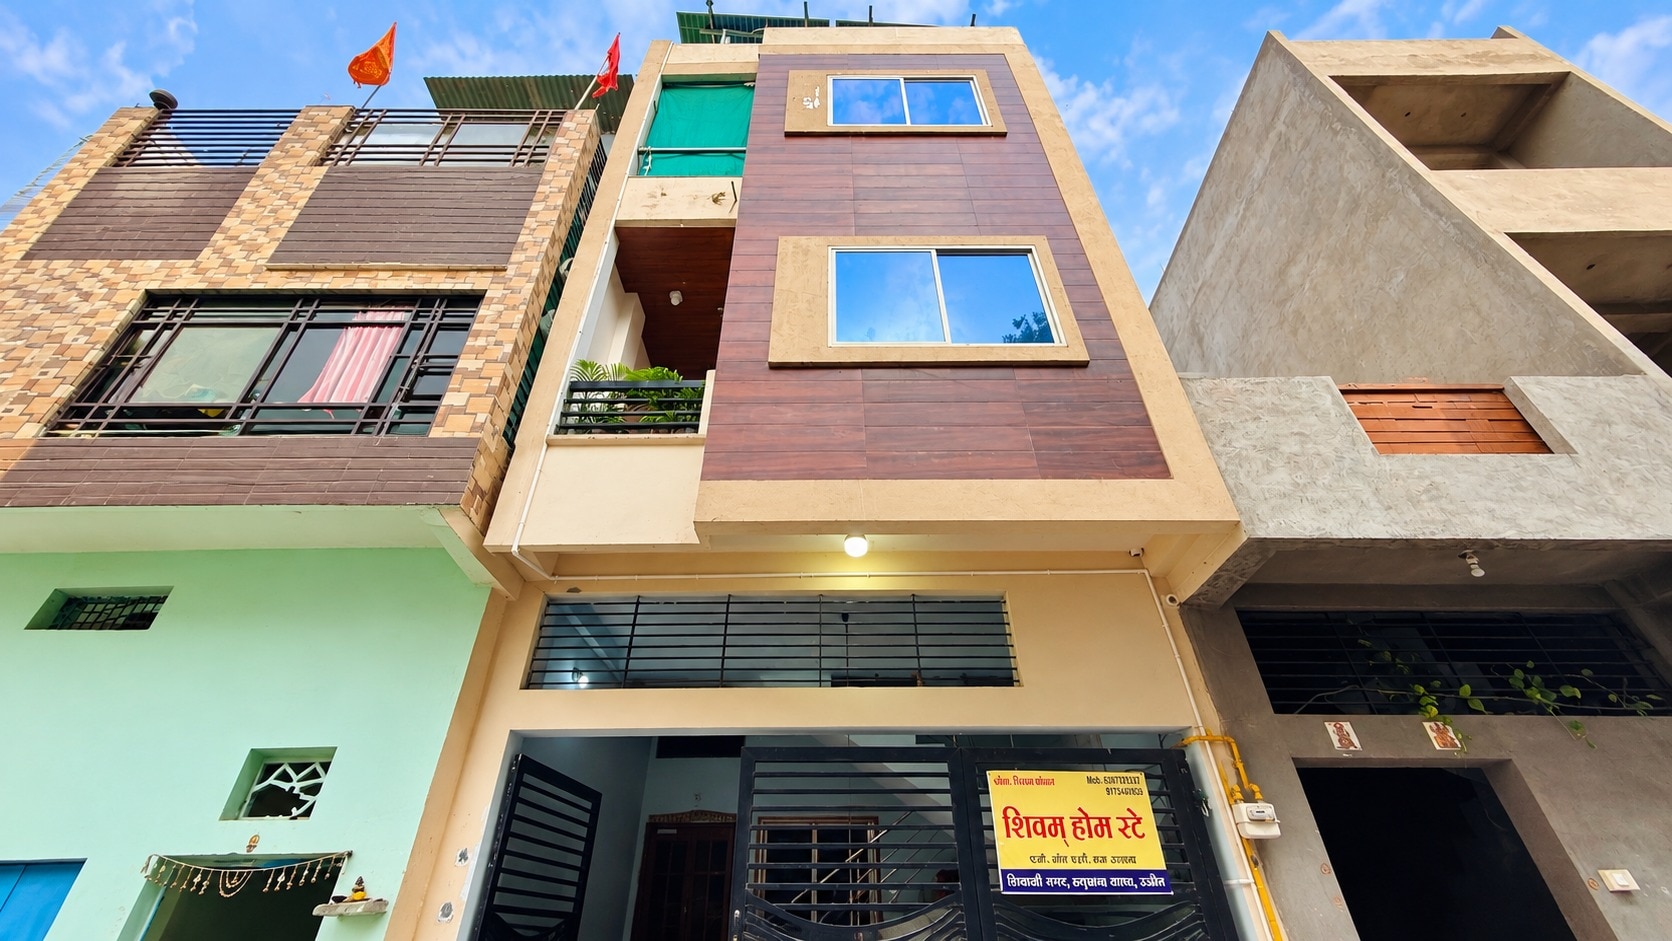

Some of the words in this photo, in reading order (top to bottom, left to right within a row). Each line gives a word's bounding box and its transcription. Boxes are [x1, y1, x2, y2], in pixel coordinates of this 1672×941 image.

[1002, 805, 1070, 847] शिवम्
[1070, 807, 1114, 841] होम
[1116, 808, 1146, 839] स्टे
